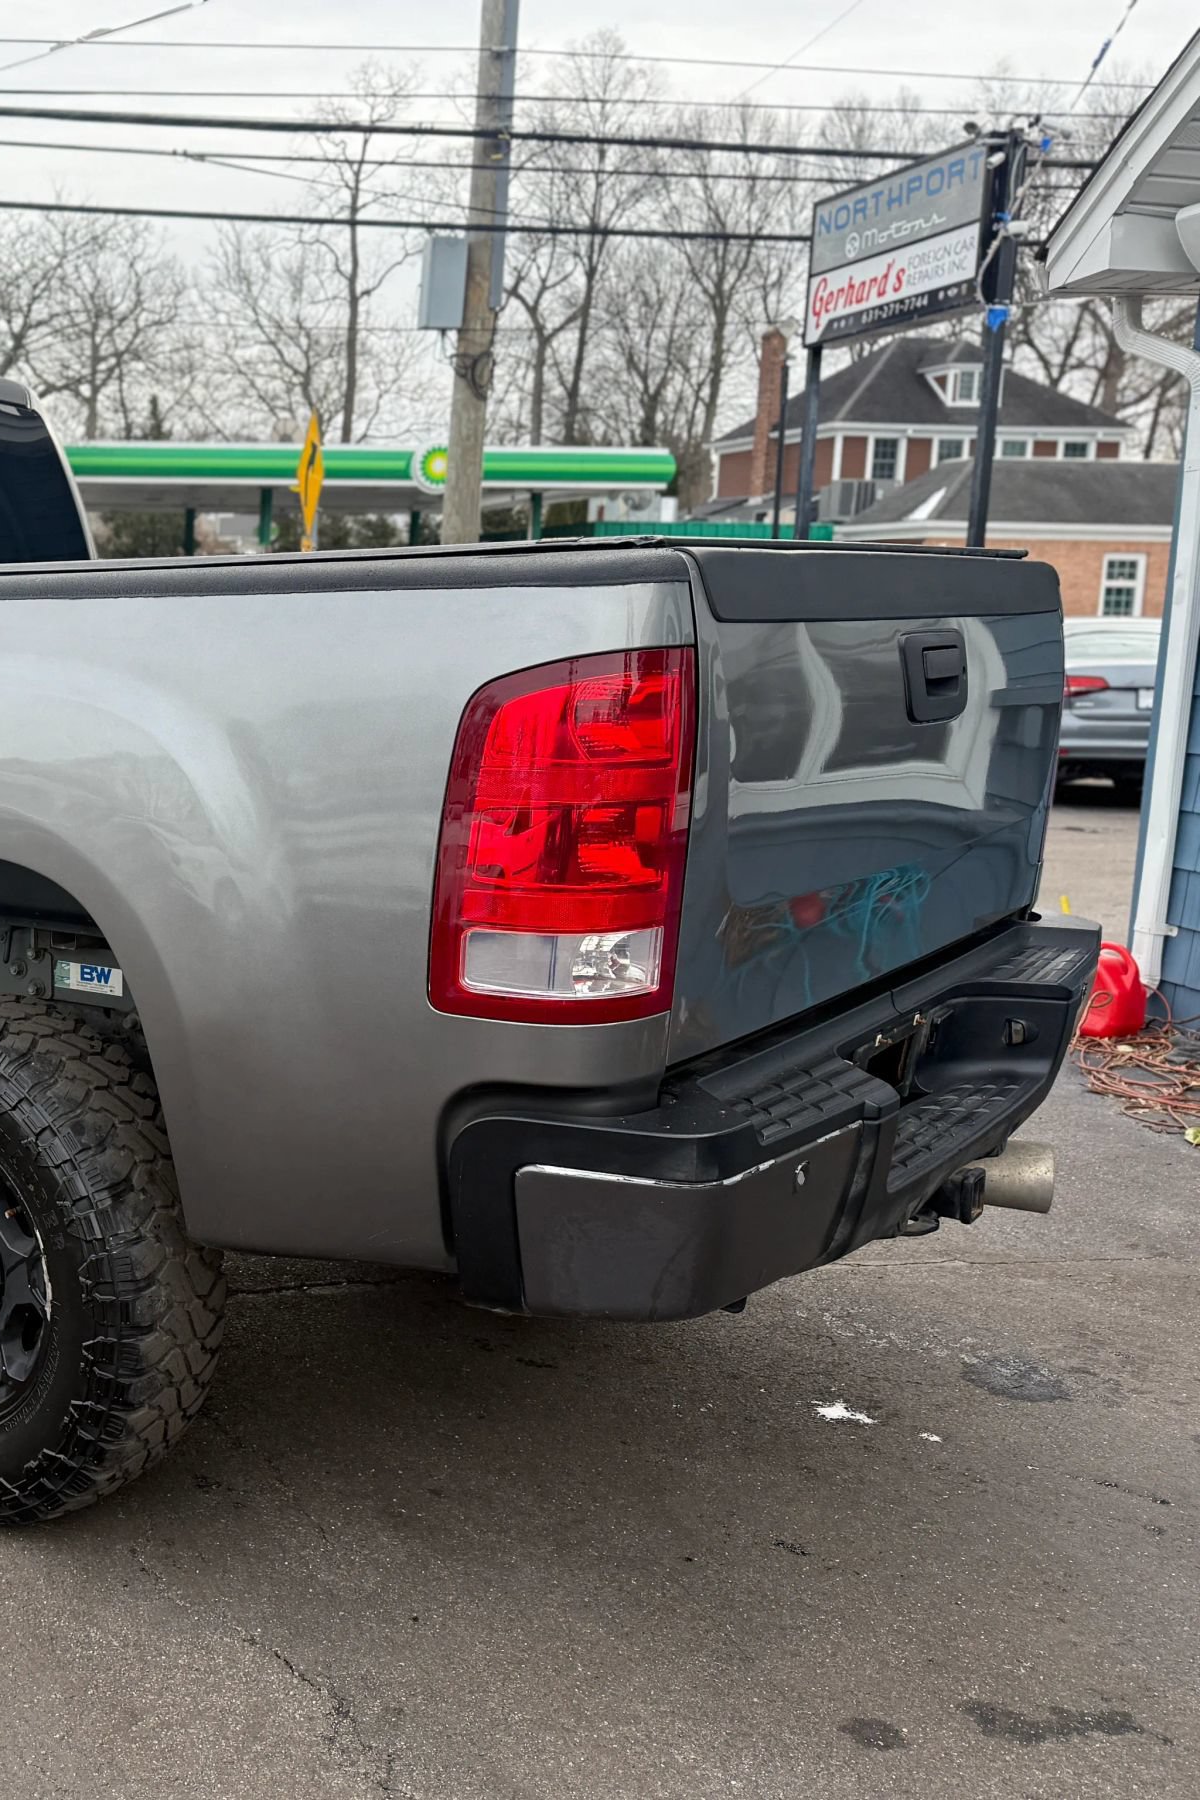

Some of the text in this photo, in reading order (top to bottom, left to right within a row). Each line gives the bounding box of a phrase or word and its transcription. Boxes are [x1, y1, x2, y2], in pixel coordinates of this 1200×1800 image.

[818, 152, 984, 237] NORTHPORT
[862, 213, 947, 249] Motors
[907, 236, 975, 270] FOREIGN CAR
[907, 255, 967, 286] REPAIRS INC
[812, 258, 906, 329] Gerhard's
[862, 294, 929, 324] 631-271-7744
